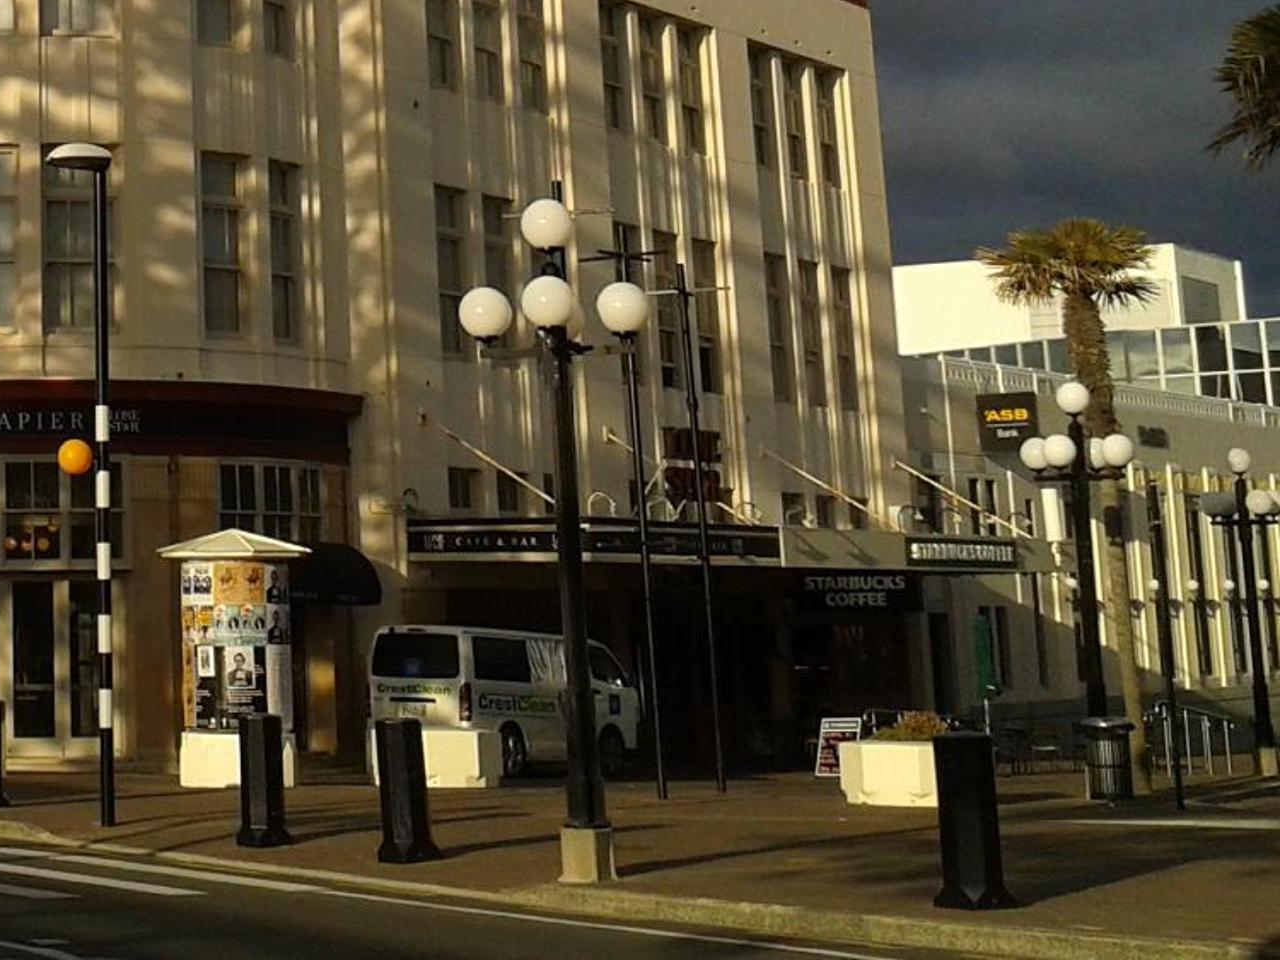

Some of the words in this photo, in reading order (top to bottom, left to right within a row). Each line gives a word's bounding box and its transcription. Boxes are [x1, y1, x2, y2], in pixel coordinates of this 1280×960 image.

[984, 407, 1029, 422] ASB
[804, 575, 906, 591] STARBUCKS
[824, 591, 888, 608] COFFEE
